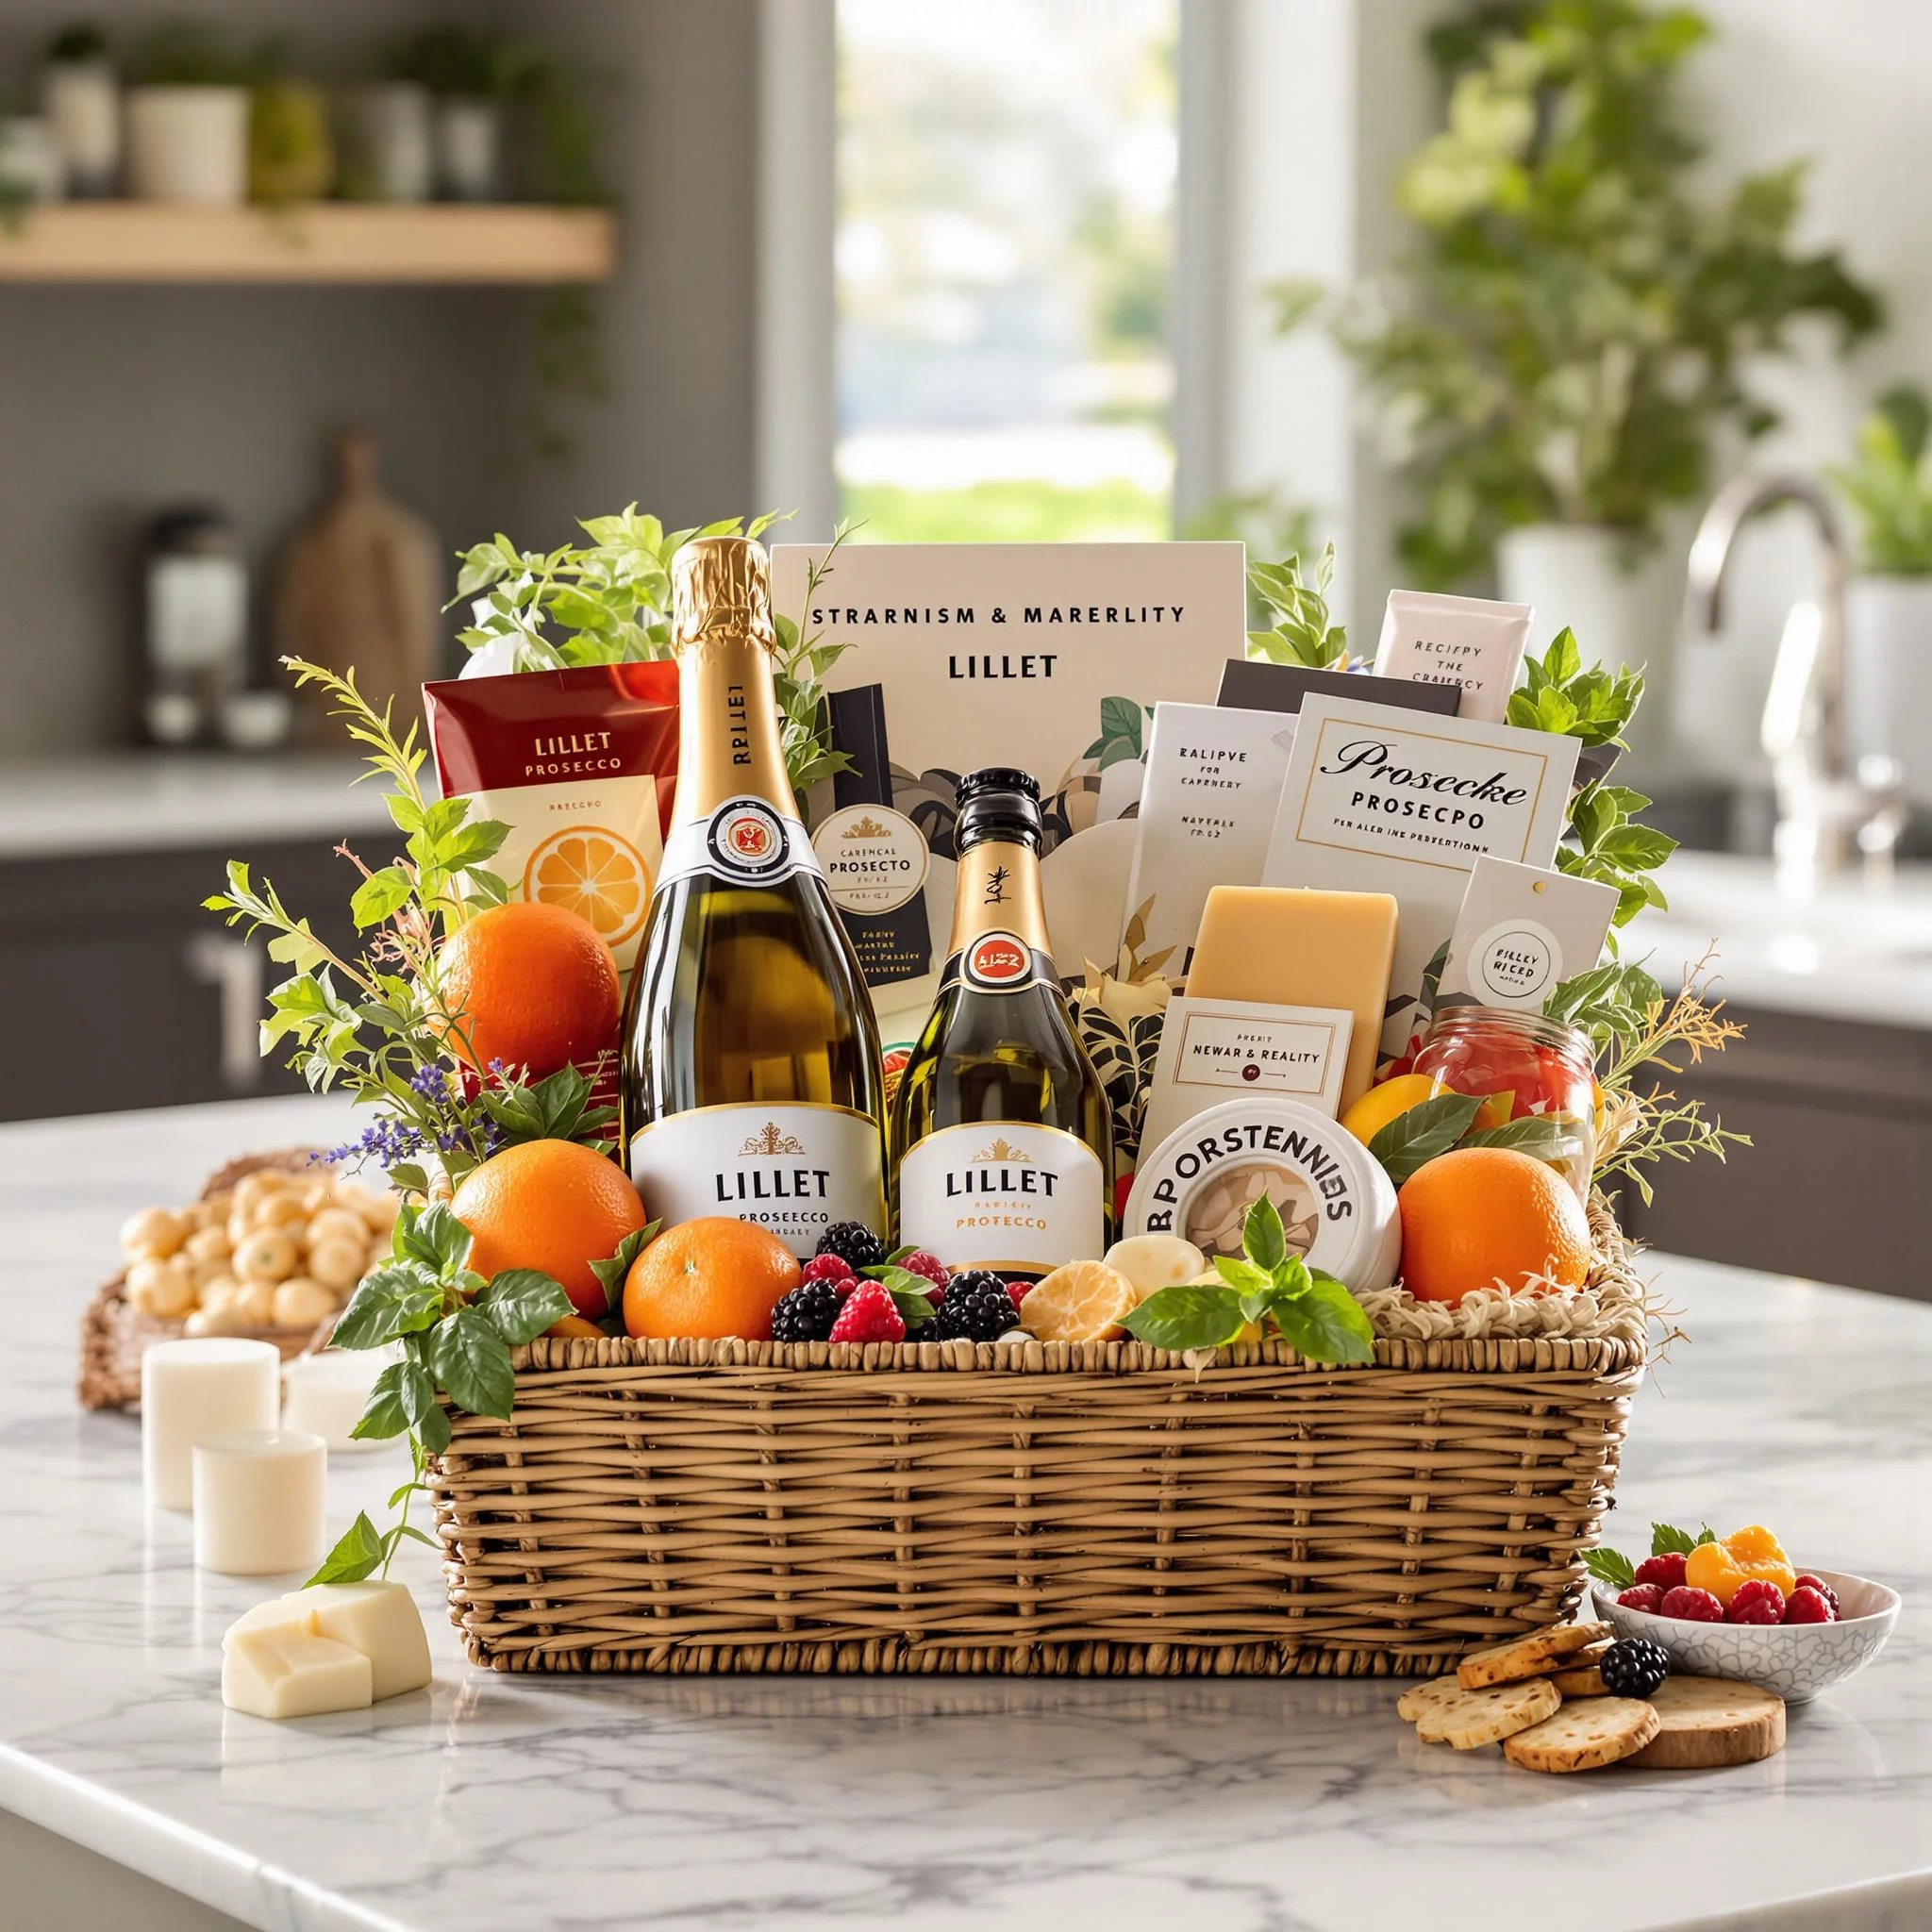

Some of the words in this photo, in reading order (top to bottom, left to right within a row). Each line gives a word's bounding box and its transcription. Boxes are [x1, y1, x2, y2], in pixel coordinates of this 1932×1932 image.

[811, 608, 975, 625] STRARNISM
[991, 608, 1007, 624] &
[1024, 607, 1185, 624] MARERLITY
[948, 655, 1058, 679] LILLET
[535, 731, 611, 757] LILLET
[525, 758, 622, 776] PROSECCO
[1351, 791, 1485, 830] PROSECPO
[829, 859, 911, 873] PROSECTO
[1192, 1044, 1241, 1058] NEWAR
[1246, 1049, 1255, 1058] &
[1261, 1049, 1320, 1064] REALITY
[715, 1169, 830, 1202] LILLET
[946, 1169, 1058, 1197] LILLET
[740, 1212, 829, 1224] PROSEECCO
